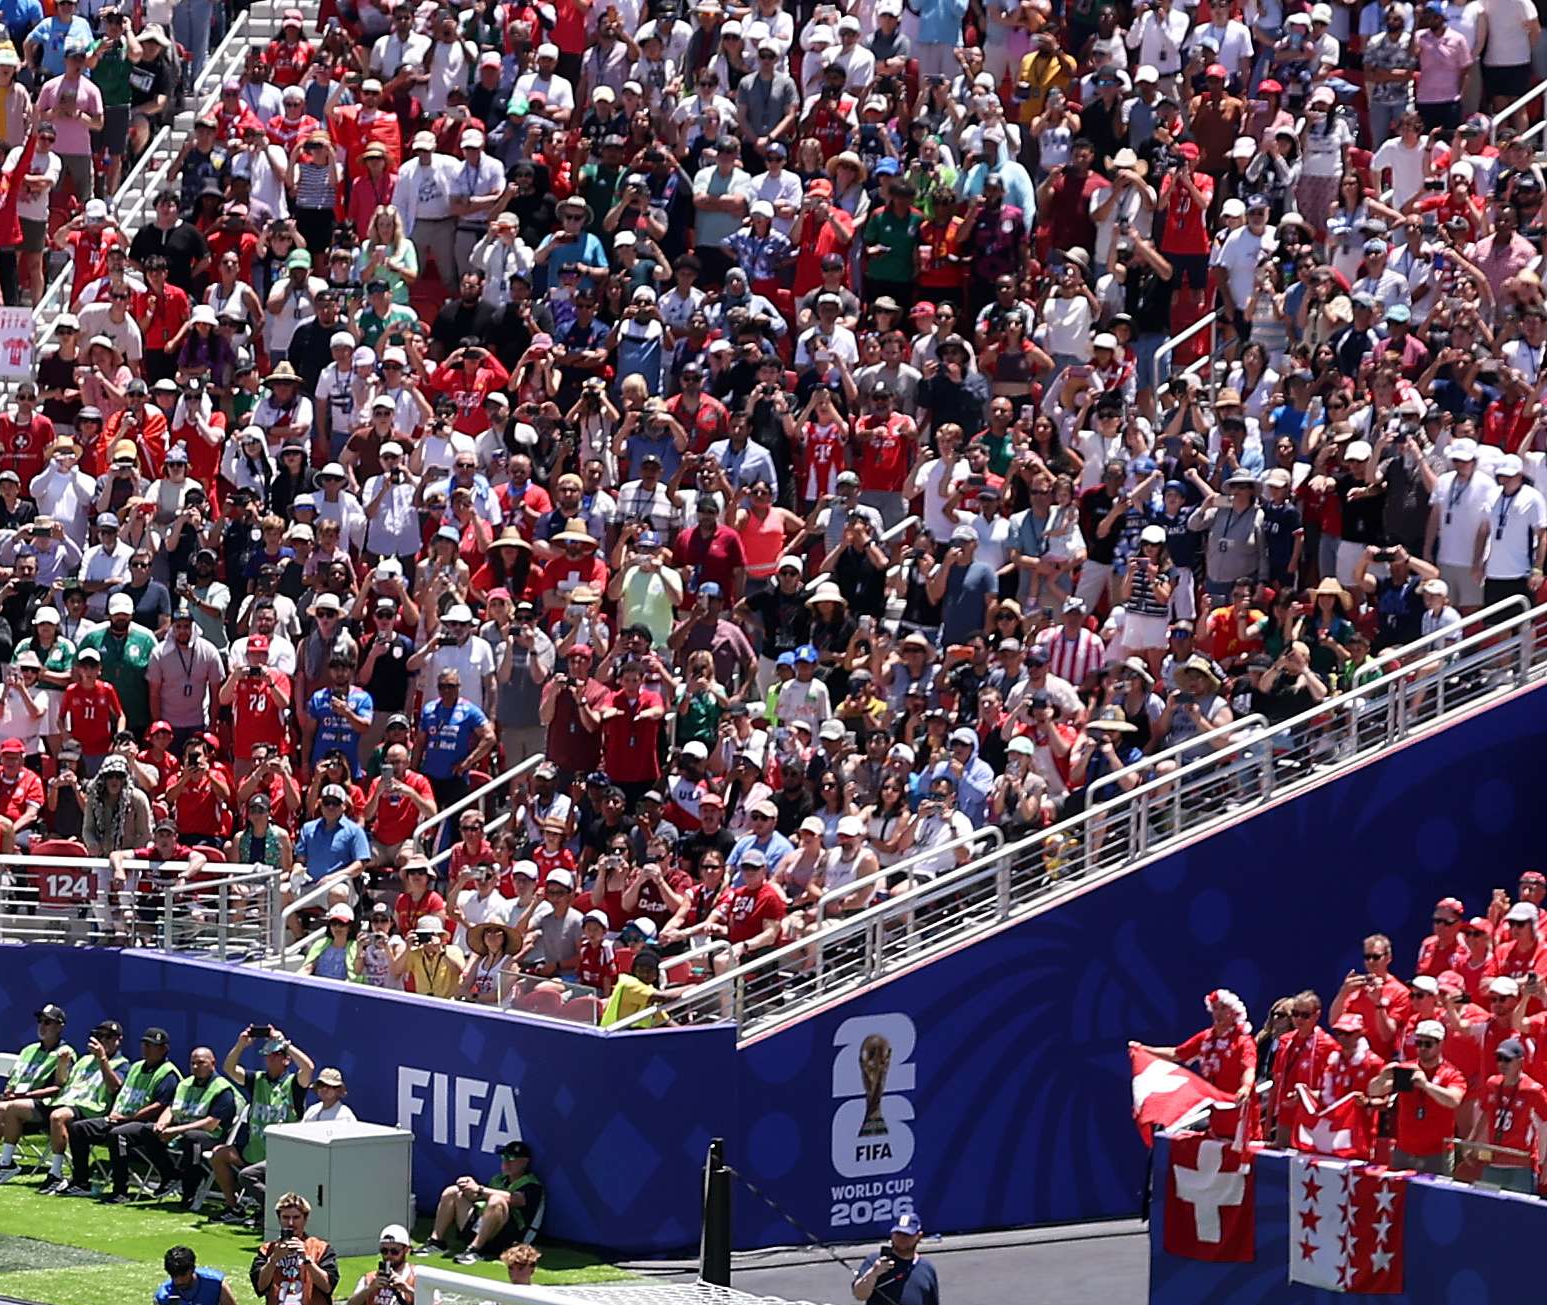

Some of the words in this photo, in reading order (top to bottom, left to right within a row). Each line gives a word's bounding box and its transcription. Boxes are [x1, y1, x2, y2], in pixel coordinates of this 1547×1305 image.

[46, 873, 90, 898] 124
[397, 1065, 523, 1154] FIFA
[855, 1143, 893, 1163] FIFA
[831, 1184, 884, 1201] WORLD
[885, 1178, 915, 1195] CUP
[830, 1196, 915, 1227] 2026
